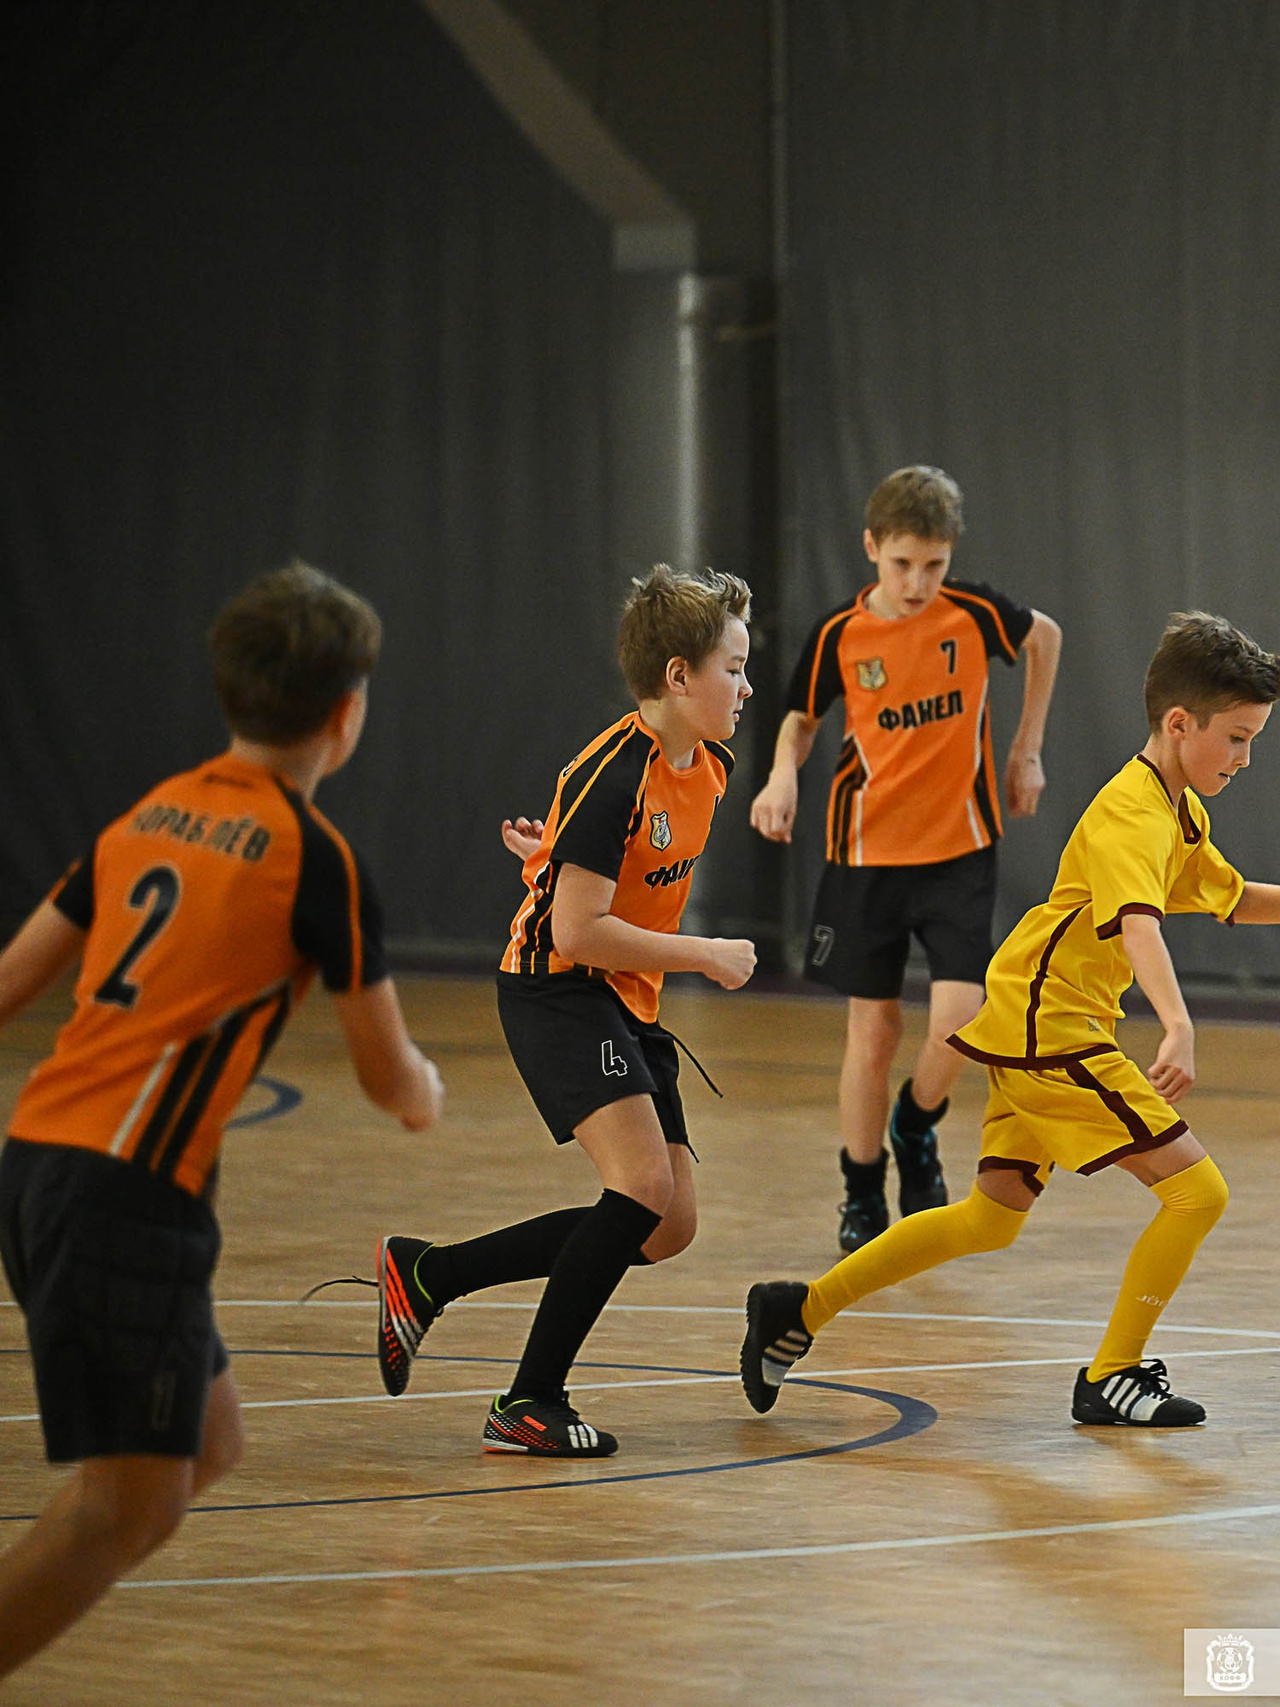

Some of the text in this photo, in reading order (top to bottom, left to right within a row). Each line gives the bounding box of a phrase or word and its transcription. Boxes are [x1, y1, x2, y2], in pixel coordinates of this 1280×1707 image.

[940, 640, 957, 675] 7
[93, 862, 182, 1009] 2
[811, 924, 835, 967] 7
[601, 1039, 628, 1077] 4
